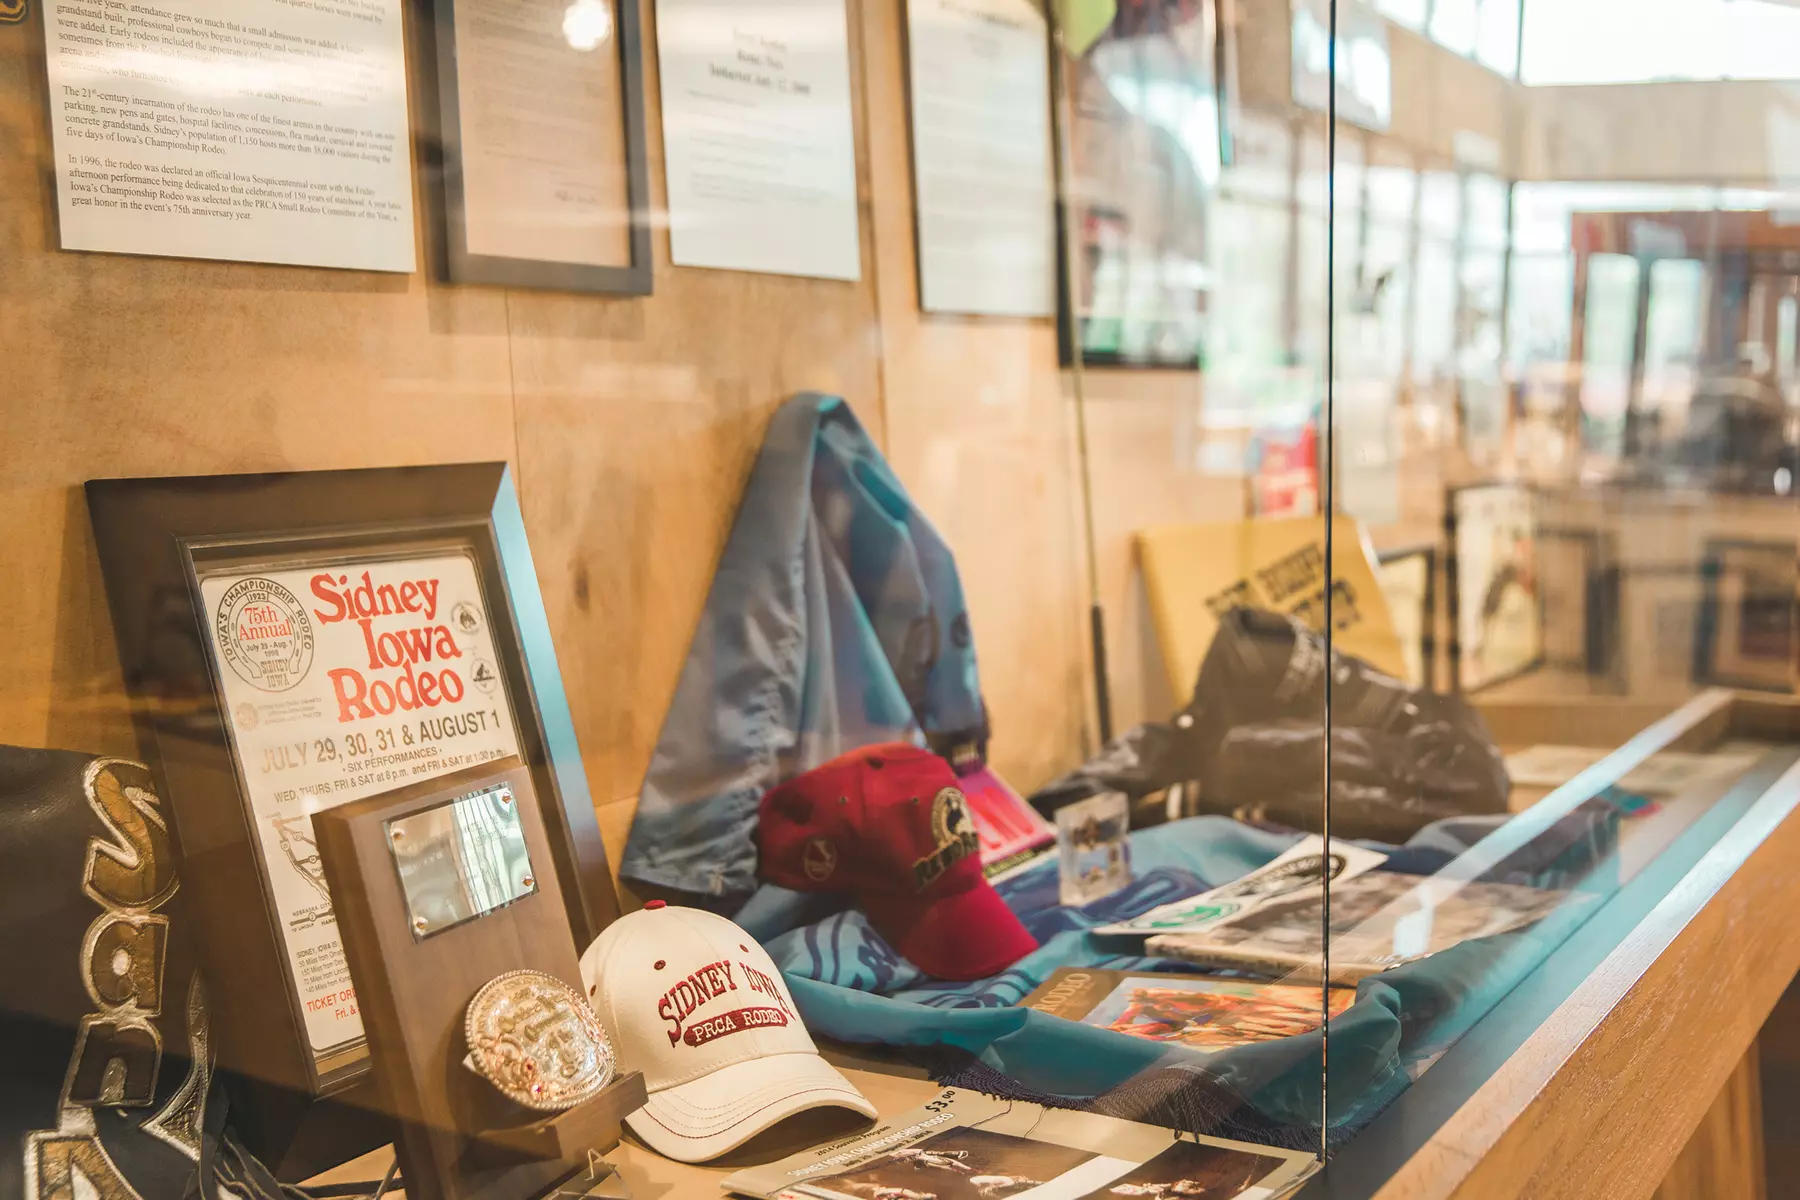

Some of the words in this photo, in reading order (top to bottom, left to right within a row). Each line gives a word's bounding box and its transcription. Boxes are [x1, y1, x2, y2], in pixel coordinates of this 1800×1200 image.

[56, 5, 102, 19] grandstand
[104, 12, 125, 24] built,
[127, 18, 174, 31] professional
[176, 27, 209, 39] cowboys
[210, 31, 232, 42] began
[66, 127, 82, 137] five
[85, 129, 104, 141] days
[106, 132, 116, 141] of
[145, 136, 200, 153] Championship
[202, 144, 227, 154] Rodeo.
[68, 154, 77, 163] In
[80, 156, 102, 167] 1996,
[104, 158, 117, 167] the
[120, 161, 142, 170] rodeo
[161, 165, 193, 176] declared
[205, 170, 231, 180] official
[233, 173, 250, 182] Iowa
[252, 175, 308, 188] Sesquicentennial
[69, 168, 108, 179] afternoon
[111, 174, 160, 185] performance
[162, 178, 183, 189] being
[184, 180, 220, 191] dedicated
[230, 185, 244, 194] that
[245, 187, 283, 198] celebration
[294, 192, 306, 200] 150
[72, 196, 92, 205] great
[94, 197, 118, 207] honor
[120, 200, 128, 208] in
[130, 201, 142, 209] the
[173, 205, 190, 214] 75th
[192, 208, 233, 219] anniversary
[100, 185, 158, 200] Championship
[160, 190, 184, 200] Rodeo
[202, 195, 231, 205] selected
[242, 199, 254, 207] the
[255, 200, 278, 209] PRCA
[278, 202, 298, 211] Small
[300, 205, 321, 213] Rodeo
[322, 207, 356, 217] Committee
[224, 580, 294, 607] CHAMPIONSHIP
[249, 593, 266, 601] 1923
[310, 571, 439, 625] Sidney
[245, 606, 278, 624] 75th
[218, 613, 236, 662] IOWA'S
[240, 619, 293, 641] Annual
[296, 610, 312, 650] RODEO
[246, 644, 259, 652] July
[273, 641, 288, 650] Aug.
[358, 618, 462, 670] Iowa
[260, 658, 288, 674] SIDNEY
[267, 673, 290, 688] IOWA
[327, 659, 464, 723] Rodeo
[262, 743, 308, 774] JULY
[314, 737, 344, 763] 29,
[346, 733, 374, 757] 30,
[376, 728, 396, 751] 31
[402, 724, 415, 746] &
[420, 711, 487, 744] AUGUST
[491, 709, 500, 728] 1
[348, 761, 362, 772] SIX
[366, 747, 438, 769] PERFORMANCES
[274, 790, 299, 803] WED,
[334, 779, 349, 790] FRI
[358, 774, 375, 785] SAT
[386, 771, 391, 780] 8
[392, 769, 409, 781] p.m.
[412, 763, 427, 775] and
[428, 760, 441, 772] FRI
[442, 760, 448, 769] &
[448, 755, 464, 767] SAT
[465, 754, 472, 763] at
[474, 751, 489, 762] 1:30
[292, 906, 318, 916] NEBRASKA
[296, 948, 317, 959] SIDNEY,
[317, 943, 331, 953] IOWA
[306, 957, 318, 966] Miles
[311, 965, 322, 974] Miles
[311, 974, 322, 983] Miles
[323, 971, 333, 980] from
[315, 982, 327, 992] Miles
[328, 979, 338, 987] from
[1032, 973, 1091, 1011] RODEO
[306, 993, 337, 1013] TICKET
[335, 1007, 349, 1020] Fri.
[350, 1005, 357, 1015] &
[658, 960, 737, 1048] SIDNEY
[739, 961, 796, 1020] IOWA
[692, 1015, 737, 1042] PRCA
[741, 1010, 782, 1025] RODEO
[925, 1090, 955, 1112] $3.00
[918, 1112, 955, 1128] RODEO
[815, 1145, 834, 1156] 2014
[833, 1136, 862, 1150] Souvenir
[862, 1125, 891, 1139] Program
